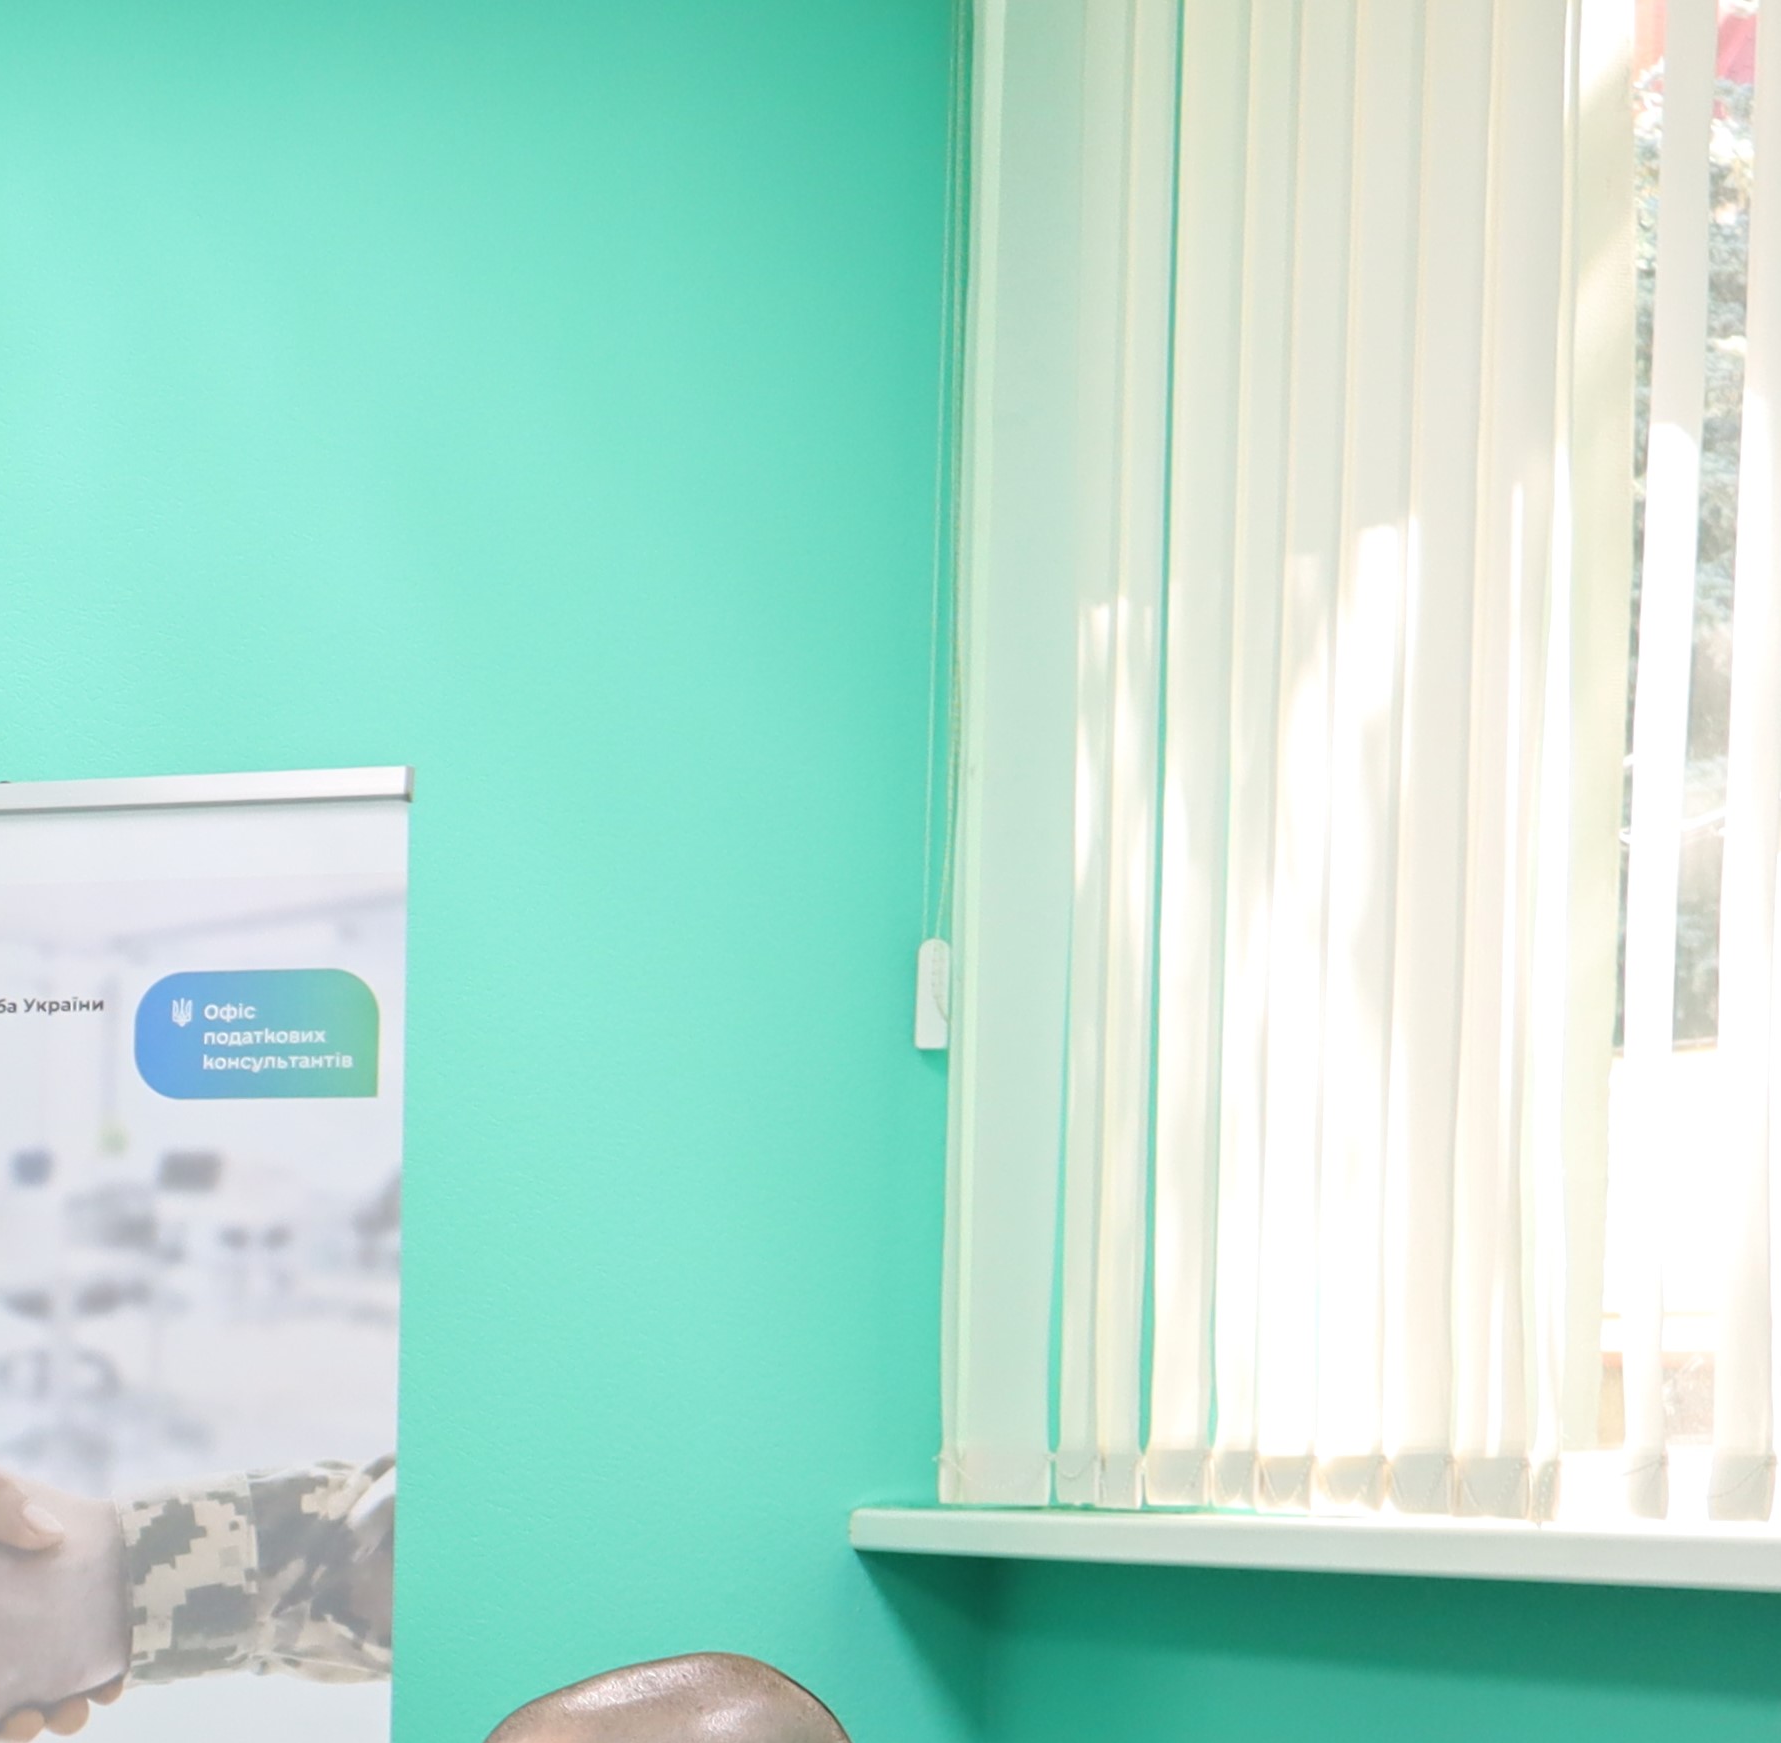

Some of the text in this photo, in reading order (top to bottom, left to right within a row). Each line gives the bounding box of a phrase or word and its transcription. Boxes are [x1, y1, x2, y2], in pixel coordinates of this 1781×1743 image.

[23, 996, 104, 1015] України
[203, 1003, 257, 1023] Офіс
[203, 1028, 327, 1047] податкових
[202, 1052, 354, 1073] консультантів
